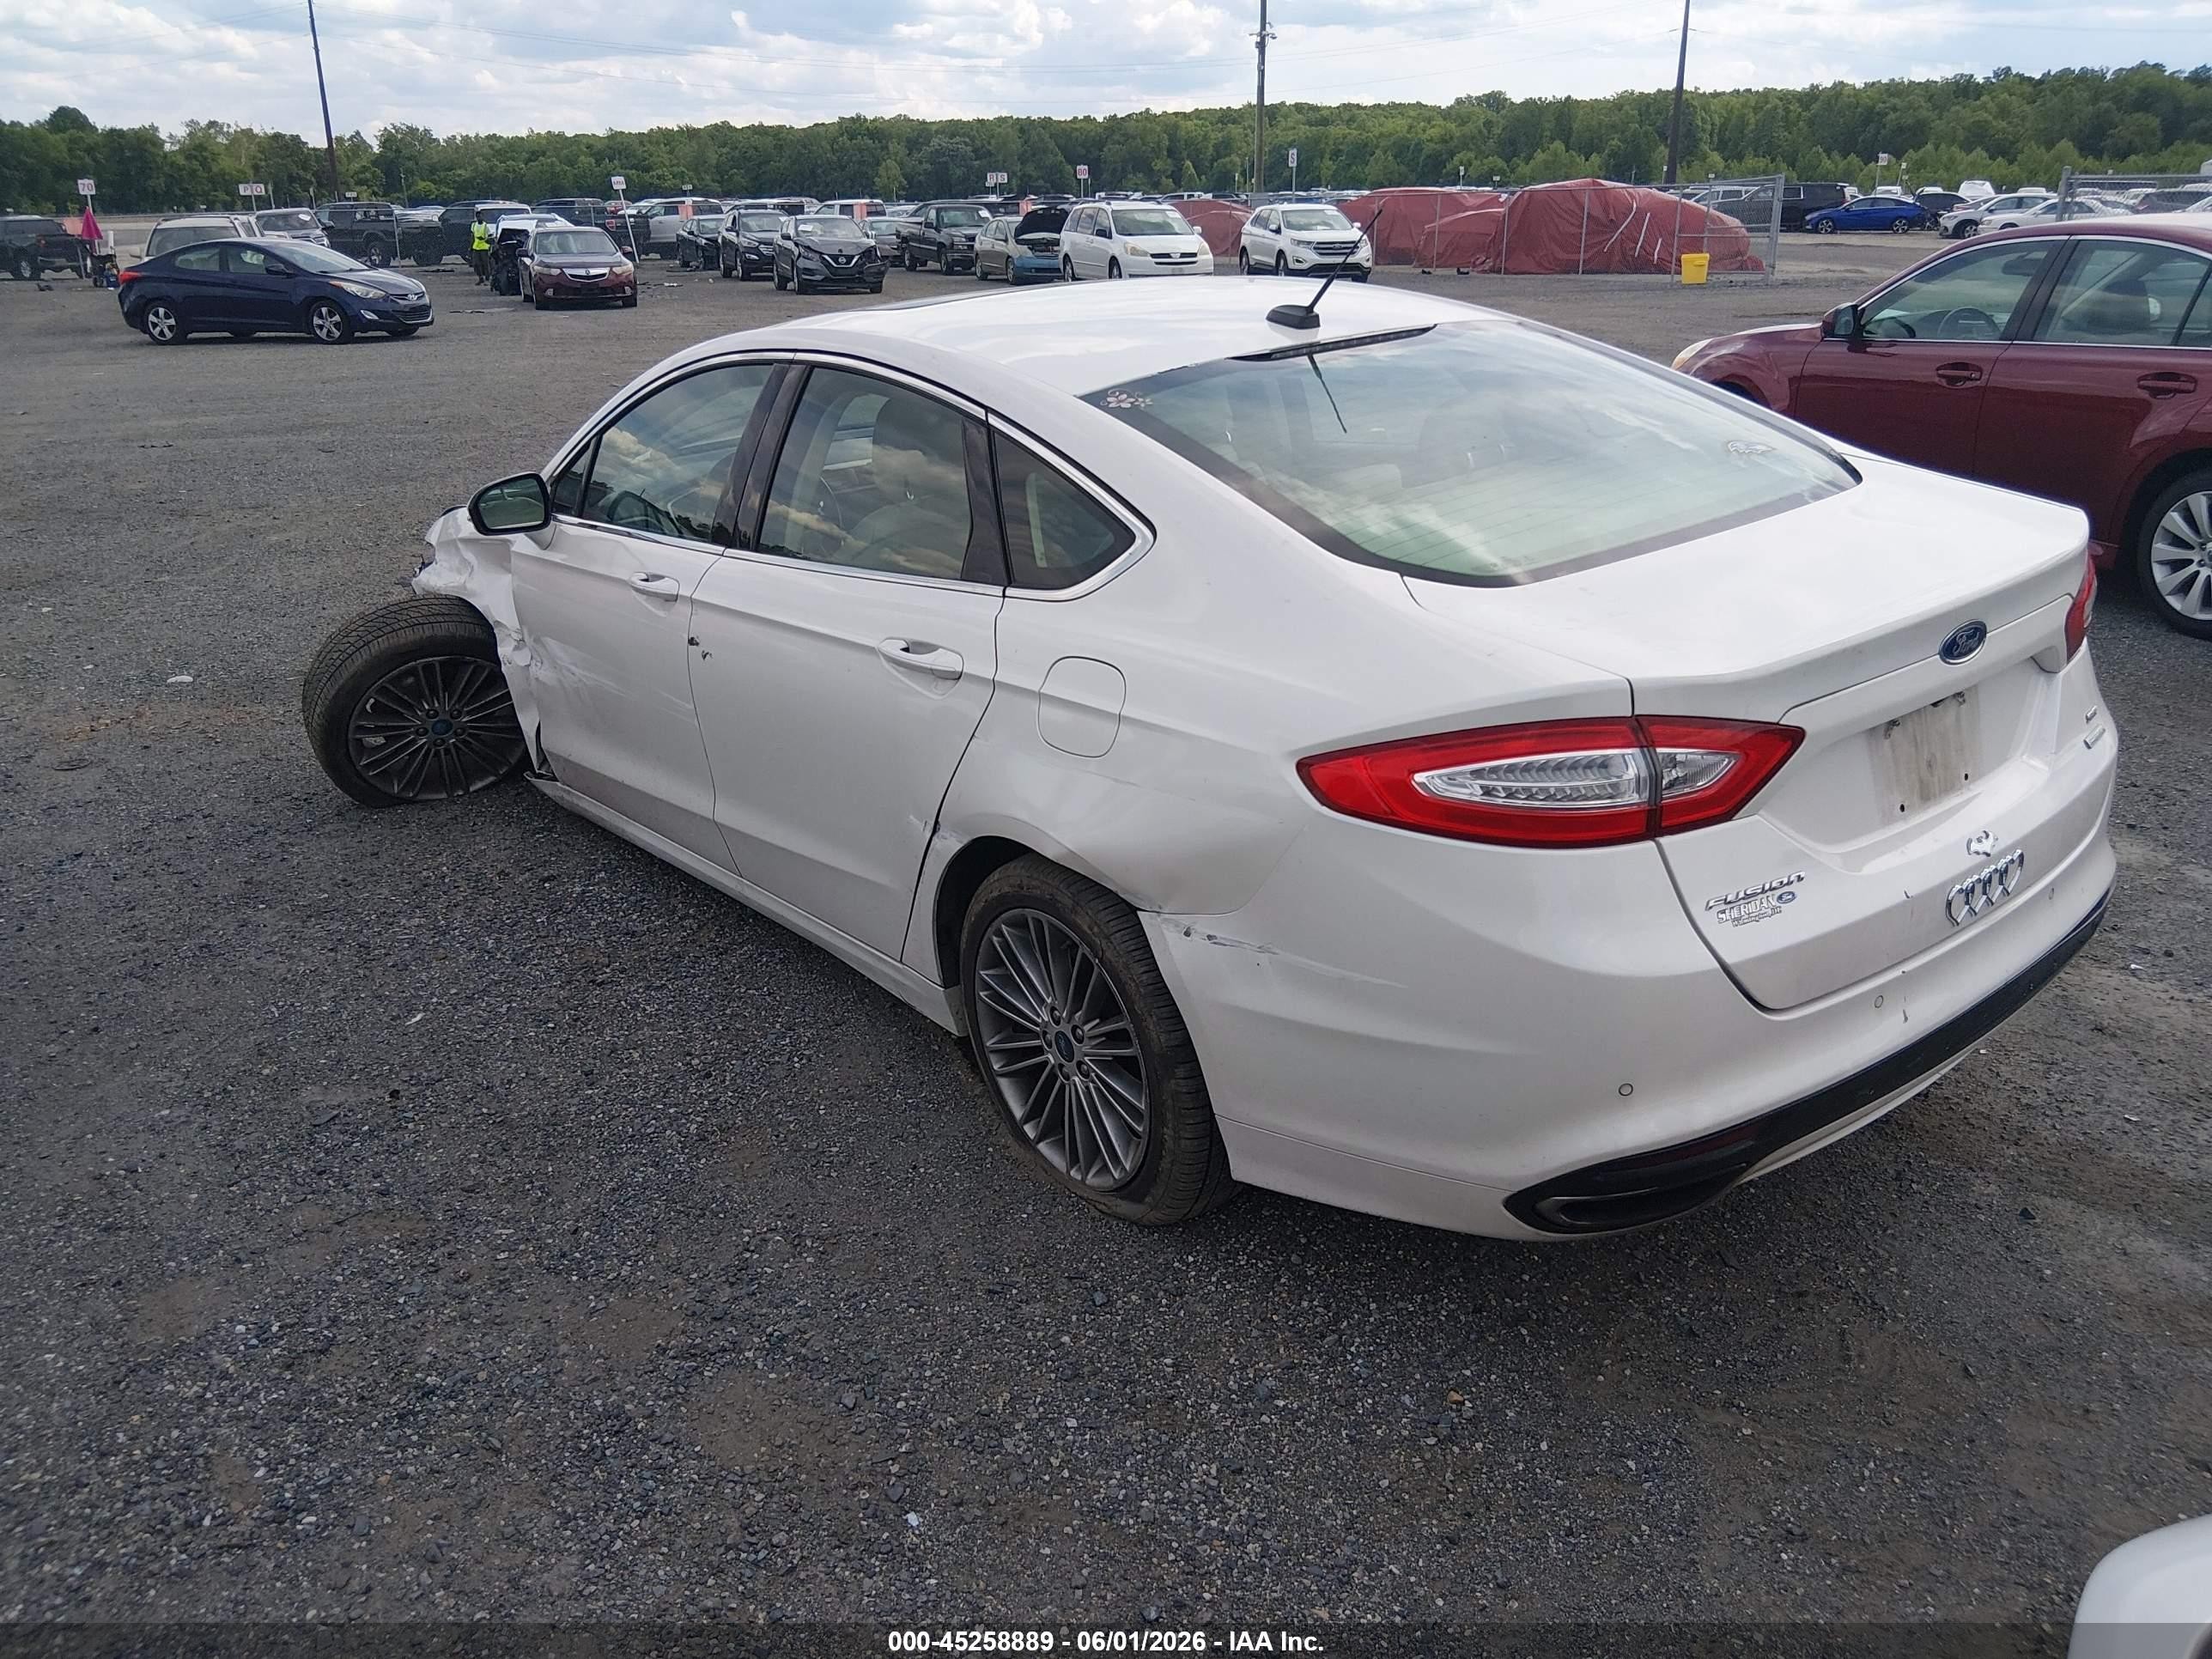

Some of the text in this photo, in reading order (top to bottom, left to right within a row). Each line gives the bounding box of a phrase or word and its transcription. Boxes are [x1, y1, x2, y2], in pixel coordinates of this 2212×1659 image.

[1291, 152, 1296, 164] S
[989, 173, 994, 182] R
[80, 183, 94, 192] 70
[255, 185, 263, 194] Q
[1952, 629, 1980, 657] Ford
[1717, 894, 1777, 924] SHERIDAN
